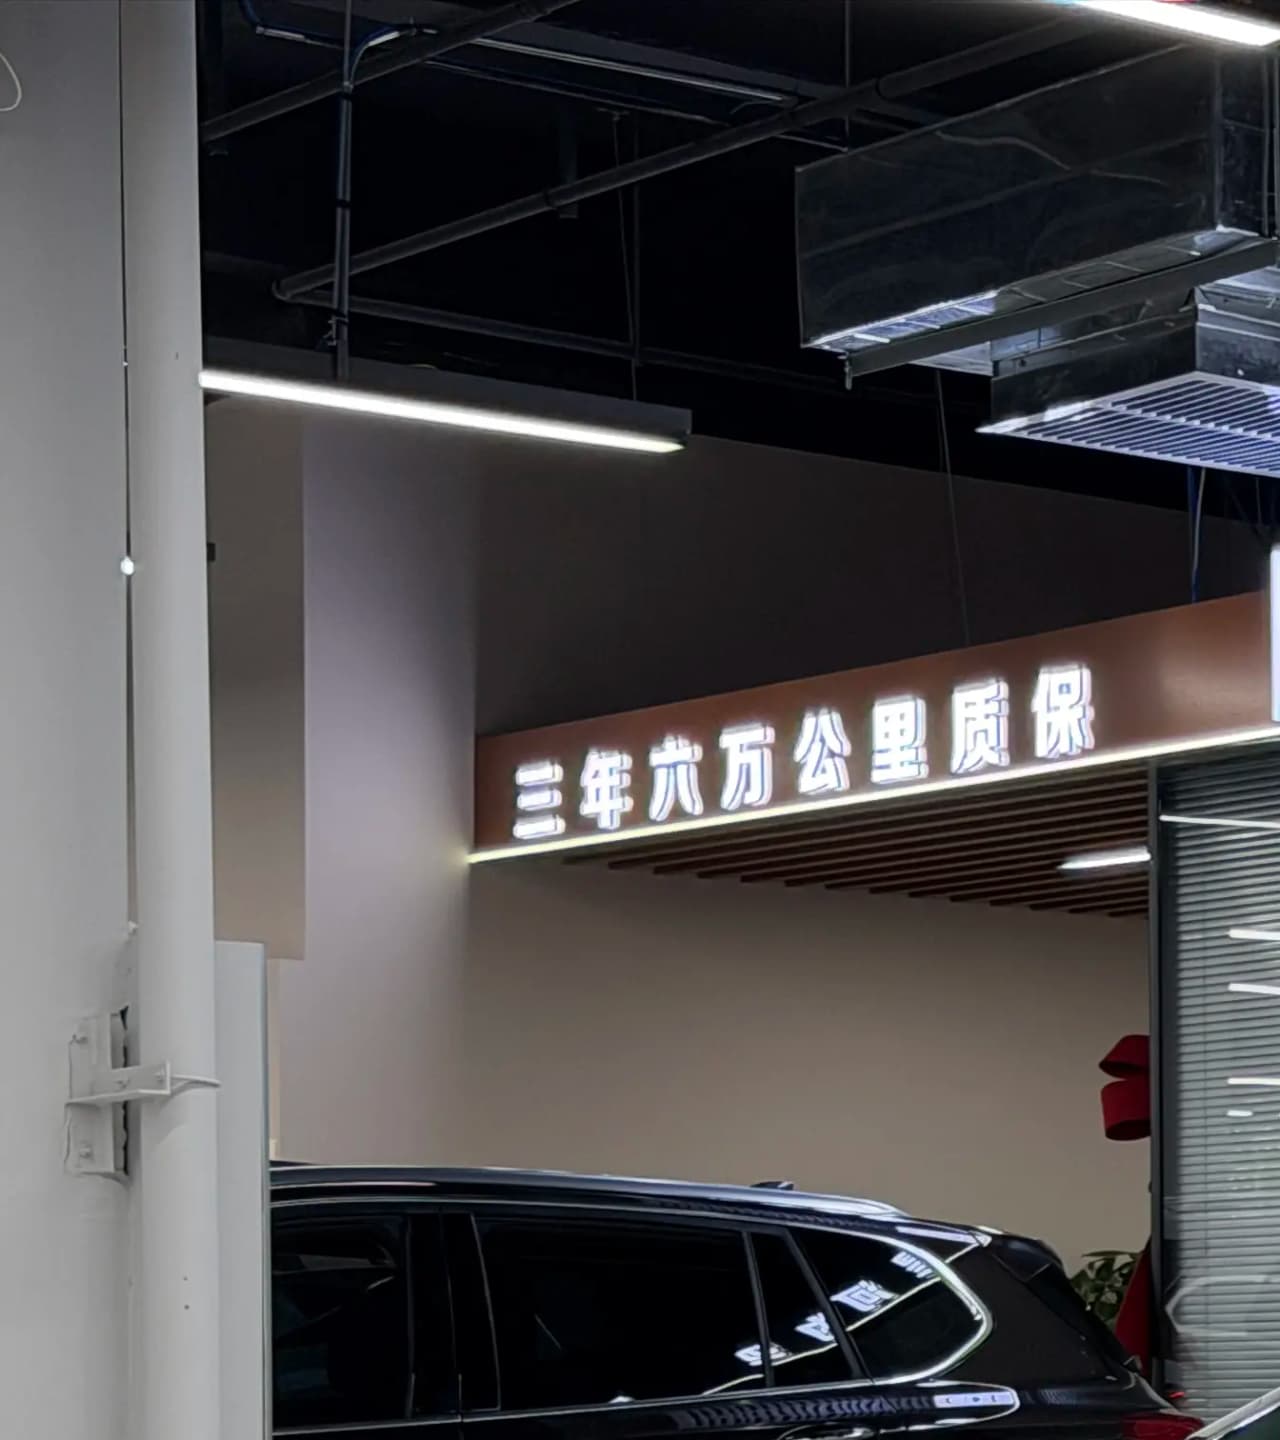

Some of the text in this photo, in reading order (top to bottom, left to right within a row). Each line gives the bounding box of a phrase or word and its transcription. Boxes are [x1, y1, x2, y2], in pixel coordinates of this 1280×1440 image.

[512, 661, 1095, 840] 三年六万公里质保
